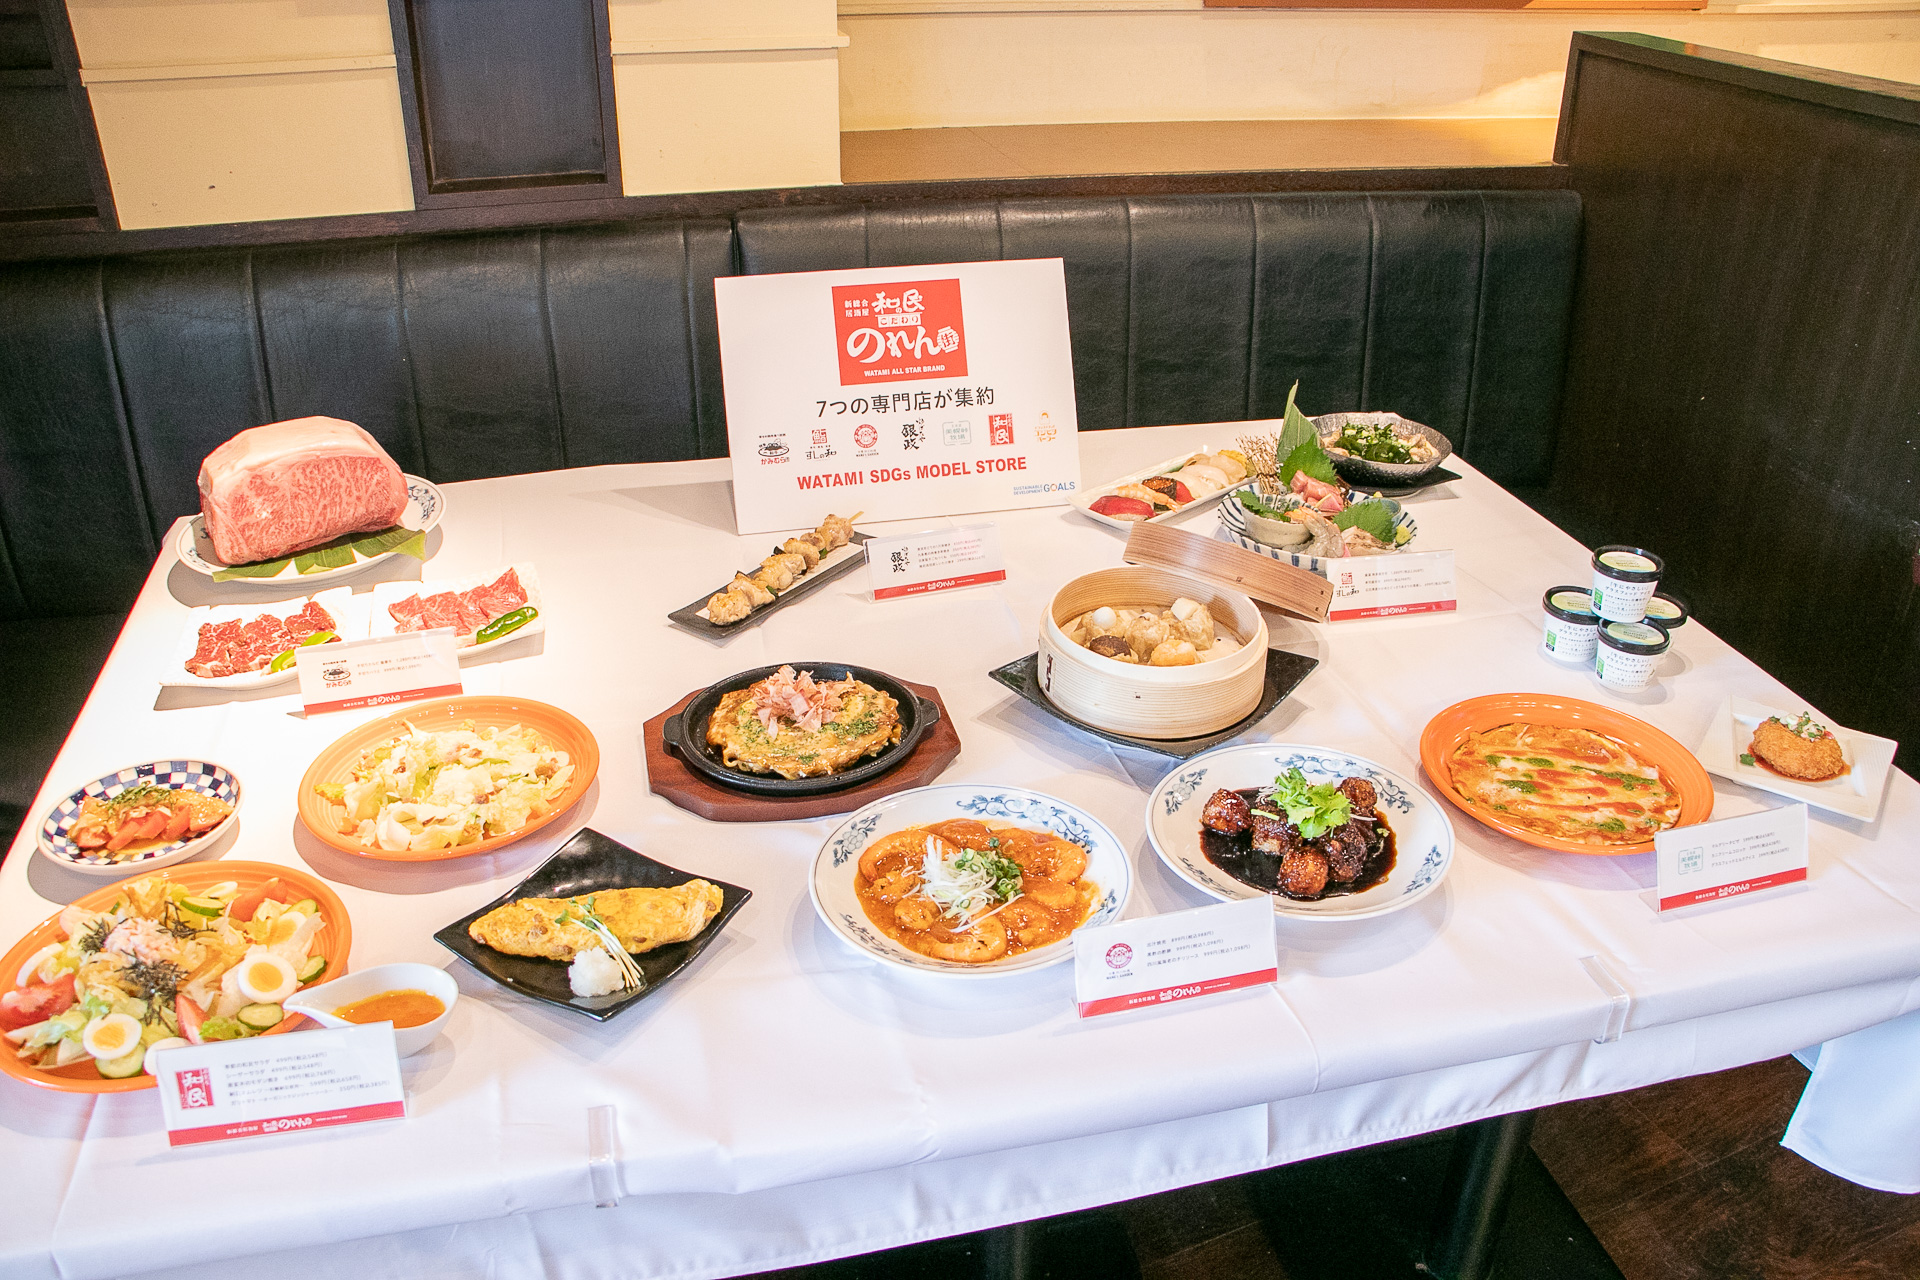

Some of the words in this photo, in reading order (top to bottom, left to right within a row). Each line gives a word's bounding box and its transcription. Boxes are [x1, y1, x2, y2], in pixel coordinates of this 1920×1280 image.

[879, 315, 919, 326] こだわり
[864, 369, 890, 377] WATAMI
[892, 367, 904, 375] ALL
[905, 366, 922, 374] STAR
[923, 364, 946, 373] BRAND
[816, 386, 995, 418] 7つの専門店が集約
[797, 470, 864, 490] WATAMI
[870, 468, 911, 483] SDGs
[916, 462, 971, 479] MODEL
[976, 456, 1027, 474] STORE
[1044, 481, 1076, 493] GOALS
